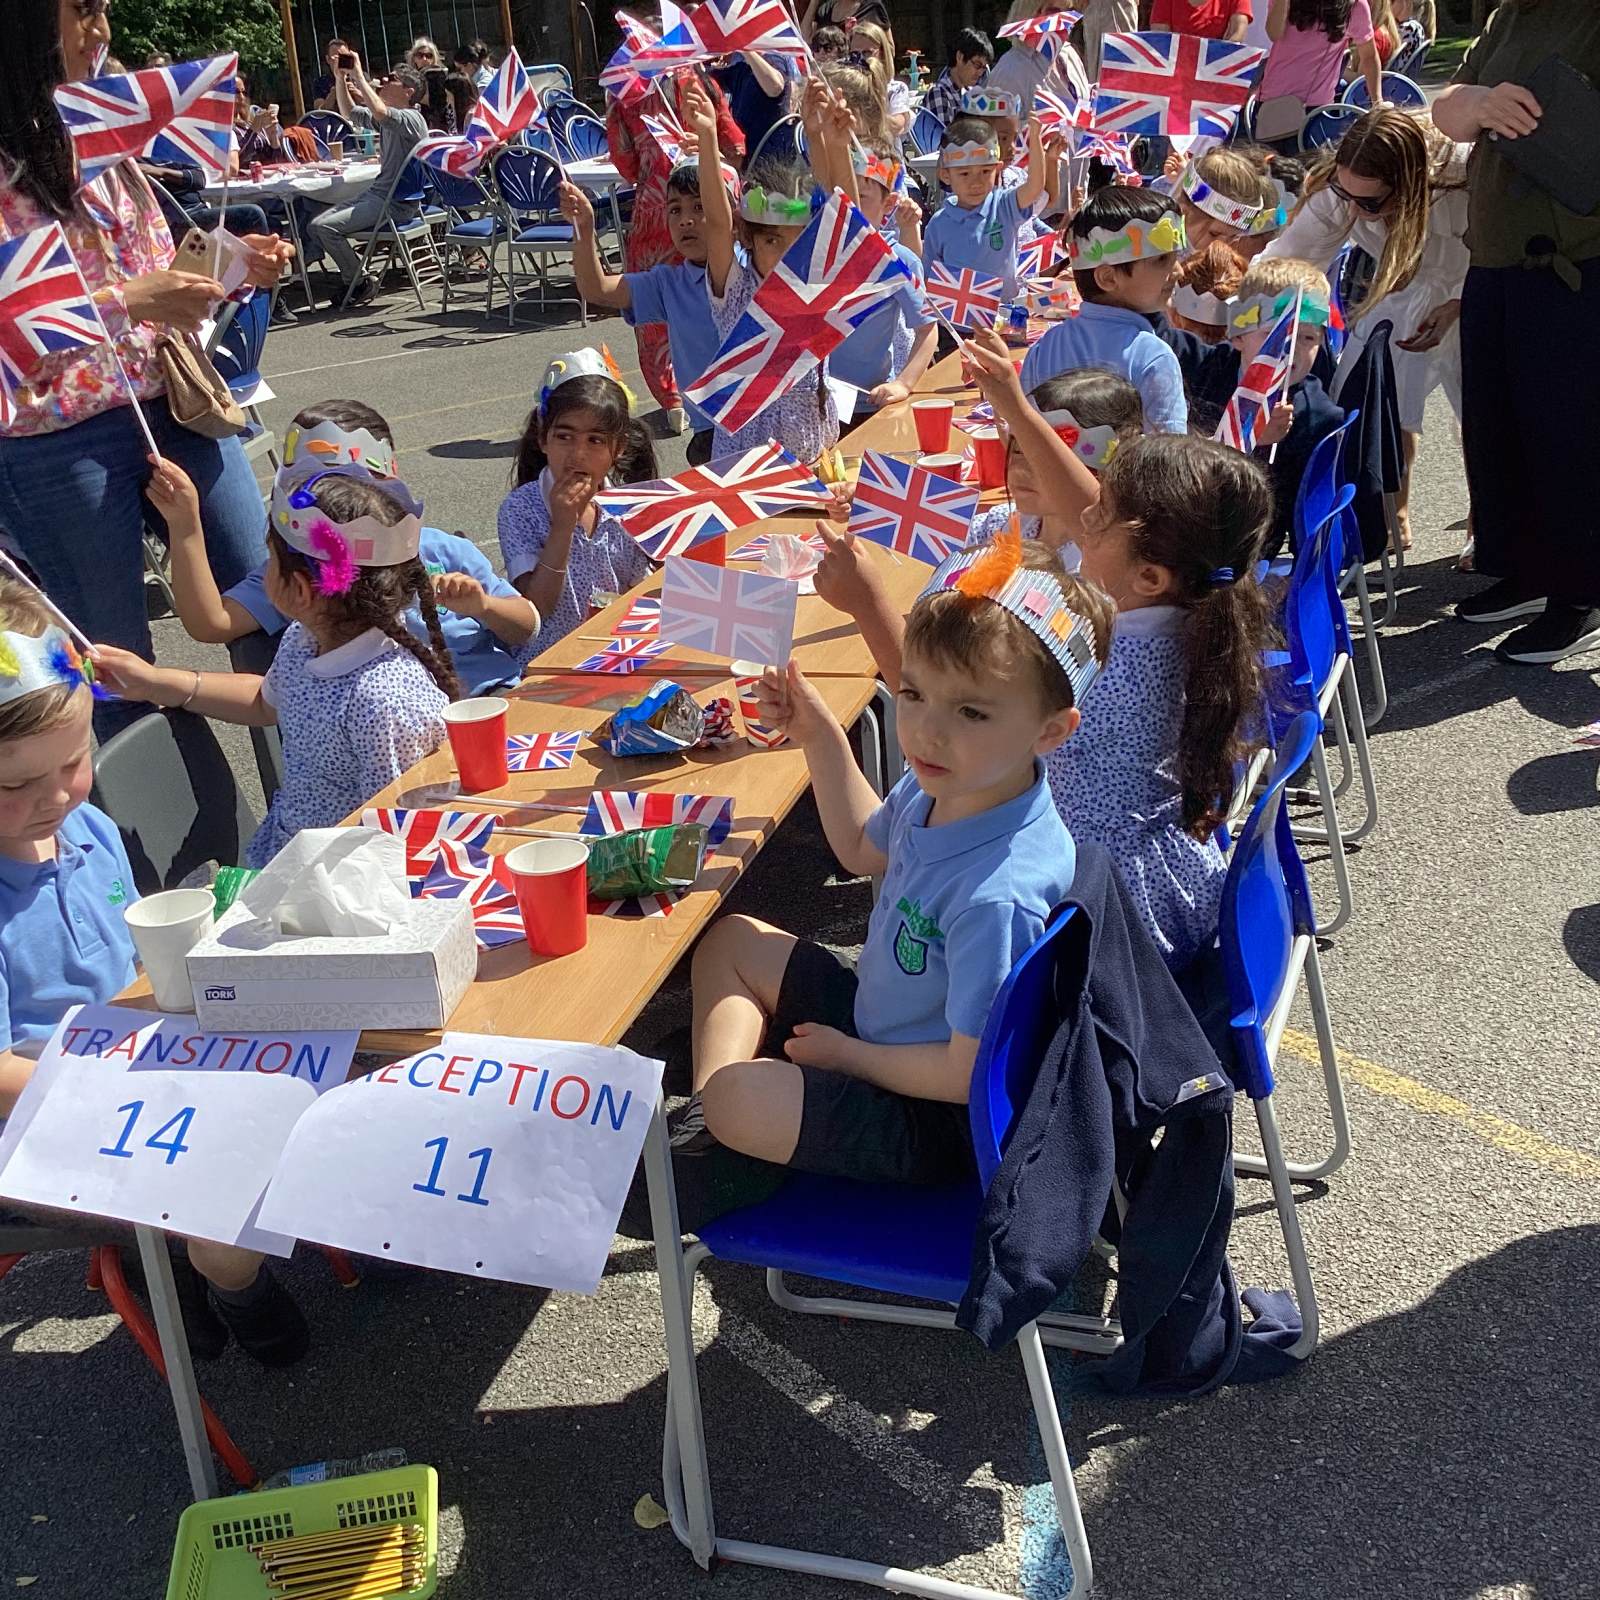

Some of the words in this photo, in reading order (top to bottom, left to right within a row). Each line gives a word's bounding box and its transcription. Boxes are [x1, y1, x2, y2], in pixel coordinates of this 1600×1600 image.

[206, 990, 235, 1000] TORK
[60, 1027, 331, 1083] TRANSITION
[364, 1053, 632, 1130] ECEPTION
[98, 1100, 197, 1165] 14
[412, 1136, 493, 1206] 11
